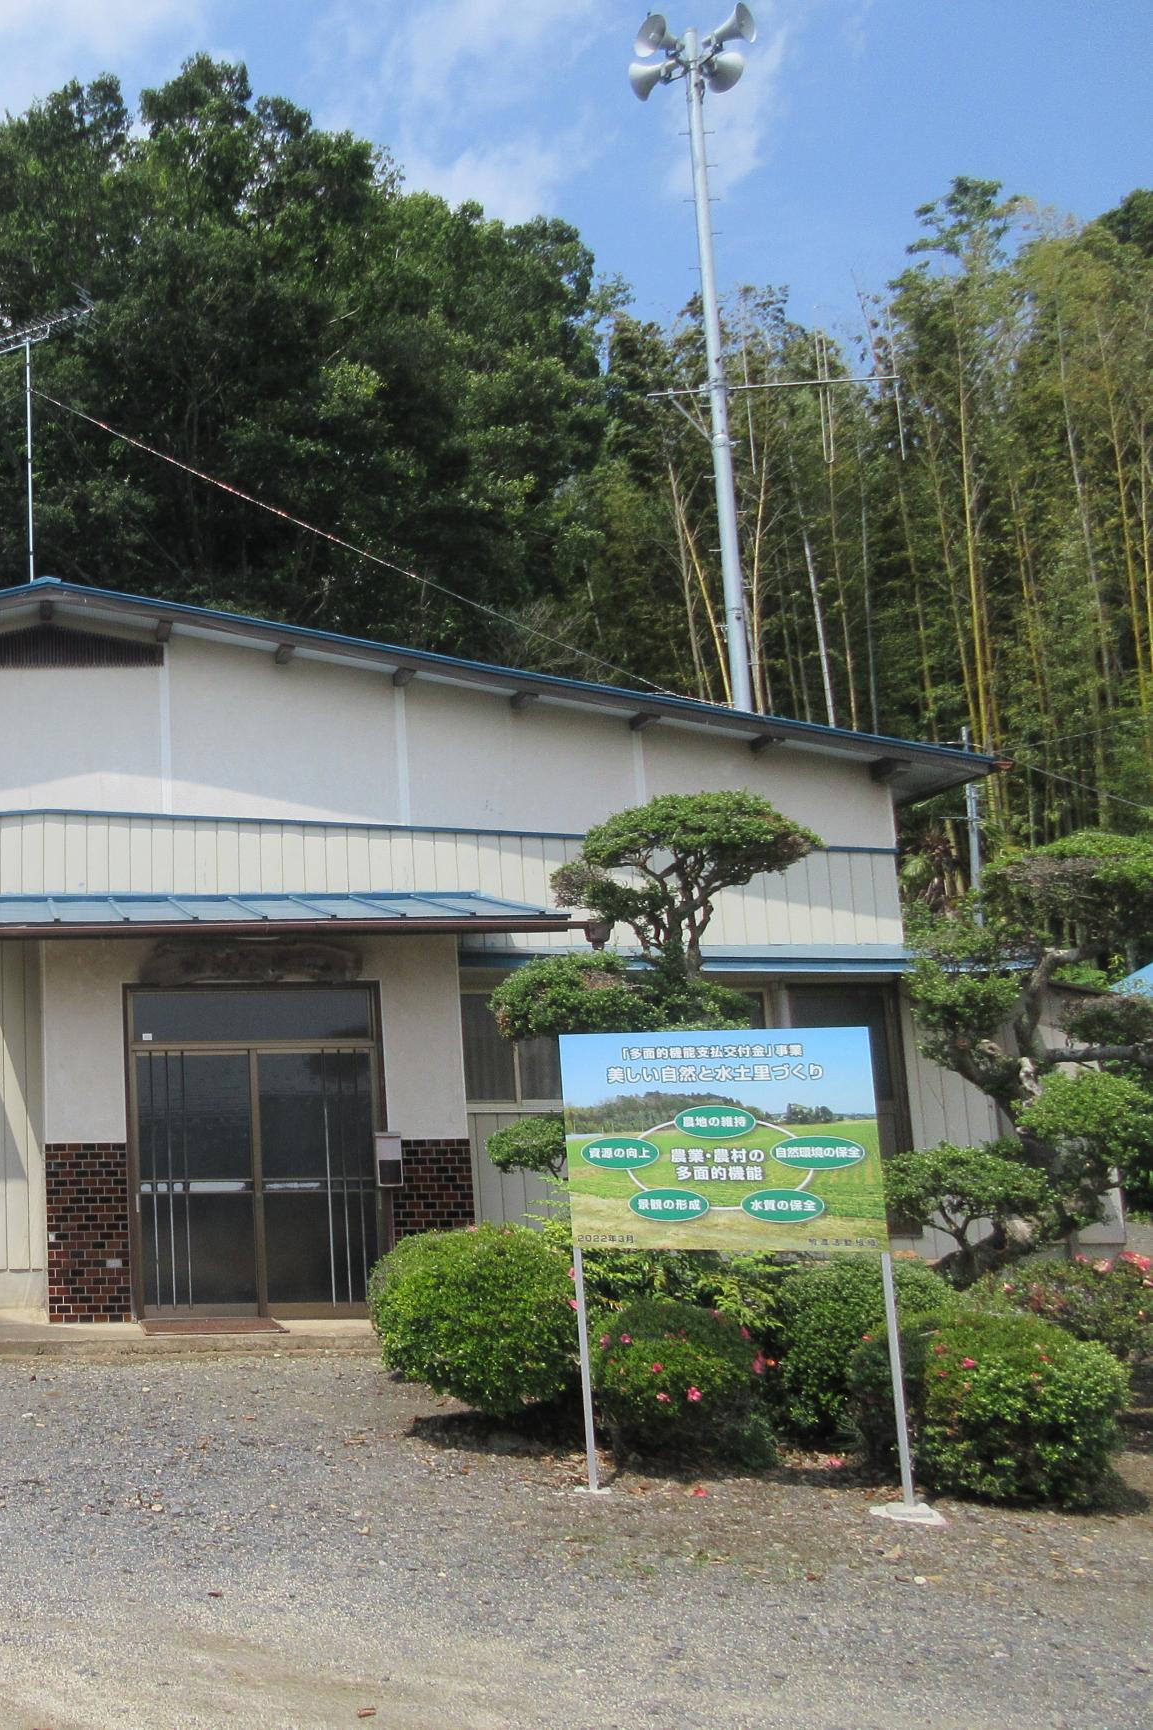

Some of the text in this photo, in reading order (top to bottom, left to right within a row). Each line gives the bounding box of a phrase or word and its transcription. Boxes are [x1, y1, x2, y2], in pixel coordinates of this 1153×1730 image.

[607, 1063, 824, 1083] 美しい自然と水土里づくり
[682, 1115, 747, 1129] 農地の維持
[589, 1147, 651, 1160] 資源の向上
[775, 1147, 861, 1159] 自然環境の保全
[676, 1165, 764, 1182] 多面的機能
[637, 1198, 702, 1212] 景観の形成
[750, 1199, 817, 1213] 水質の保全
[577, 1234, 634, 1244] 2022年3月
